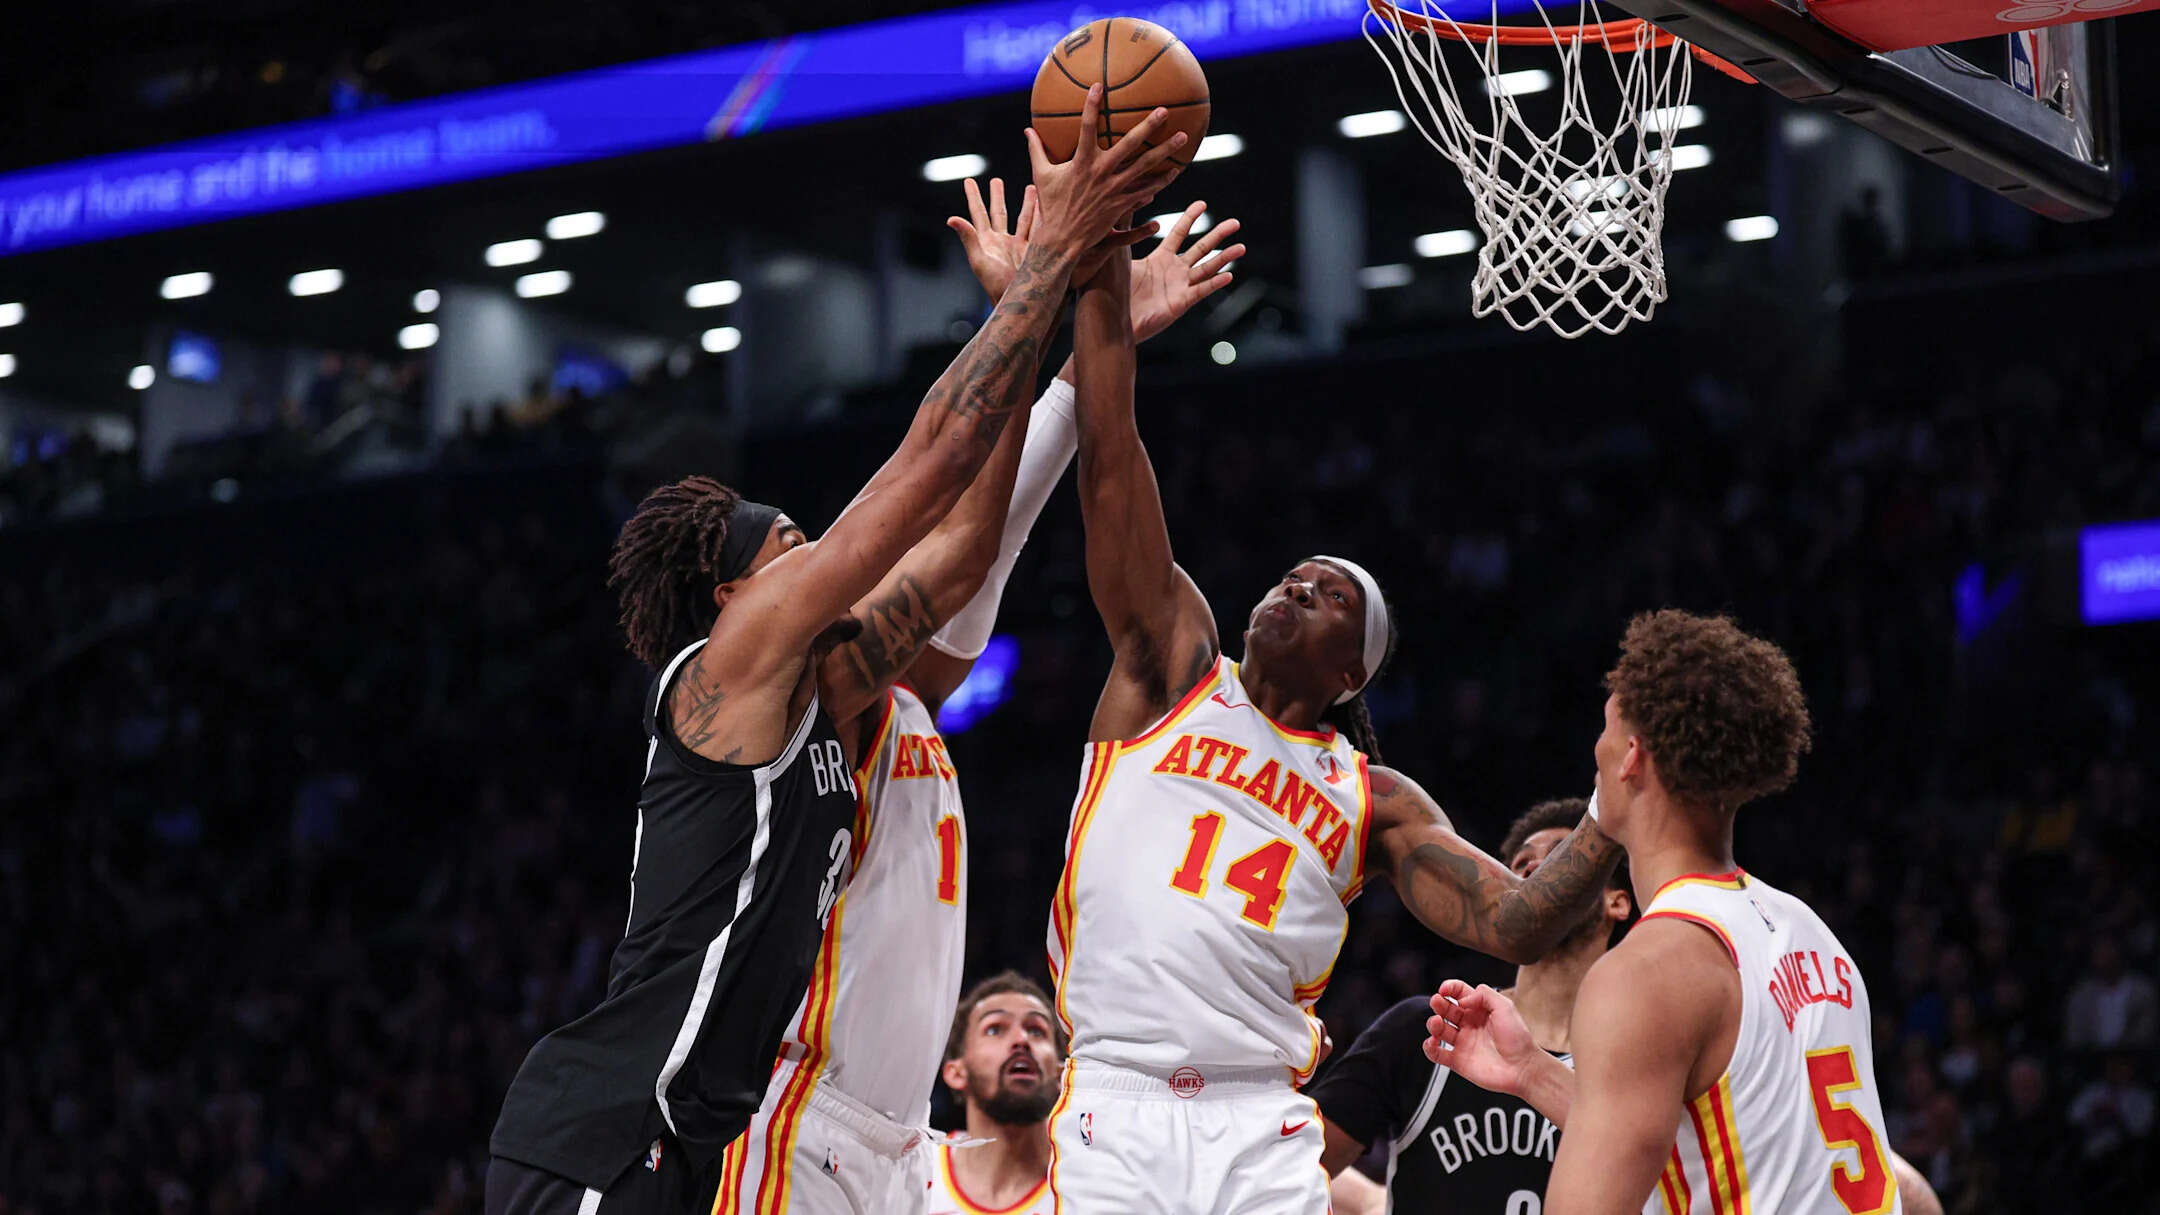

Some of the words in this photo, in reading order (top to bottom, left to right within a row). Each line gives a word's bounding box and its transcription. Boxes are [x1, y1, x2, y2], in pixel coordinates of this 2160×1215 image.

[2014, 57, 2032, 91] NBA
[1152, 734, 1351, 875] ATLANTA
[936, 813, 961, 905] 1
[1168, 809, 1299, 933] 14
[1769, 951, 1852, 1034] DANIELS
[1168, 1077, 1205, 1089] HAWKS
[1805, 1045, 1897, 1215] 5
